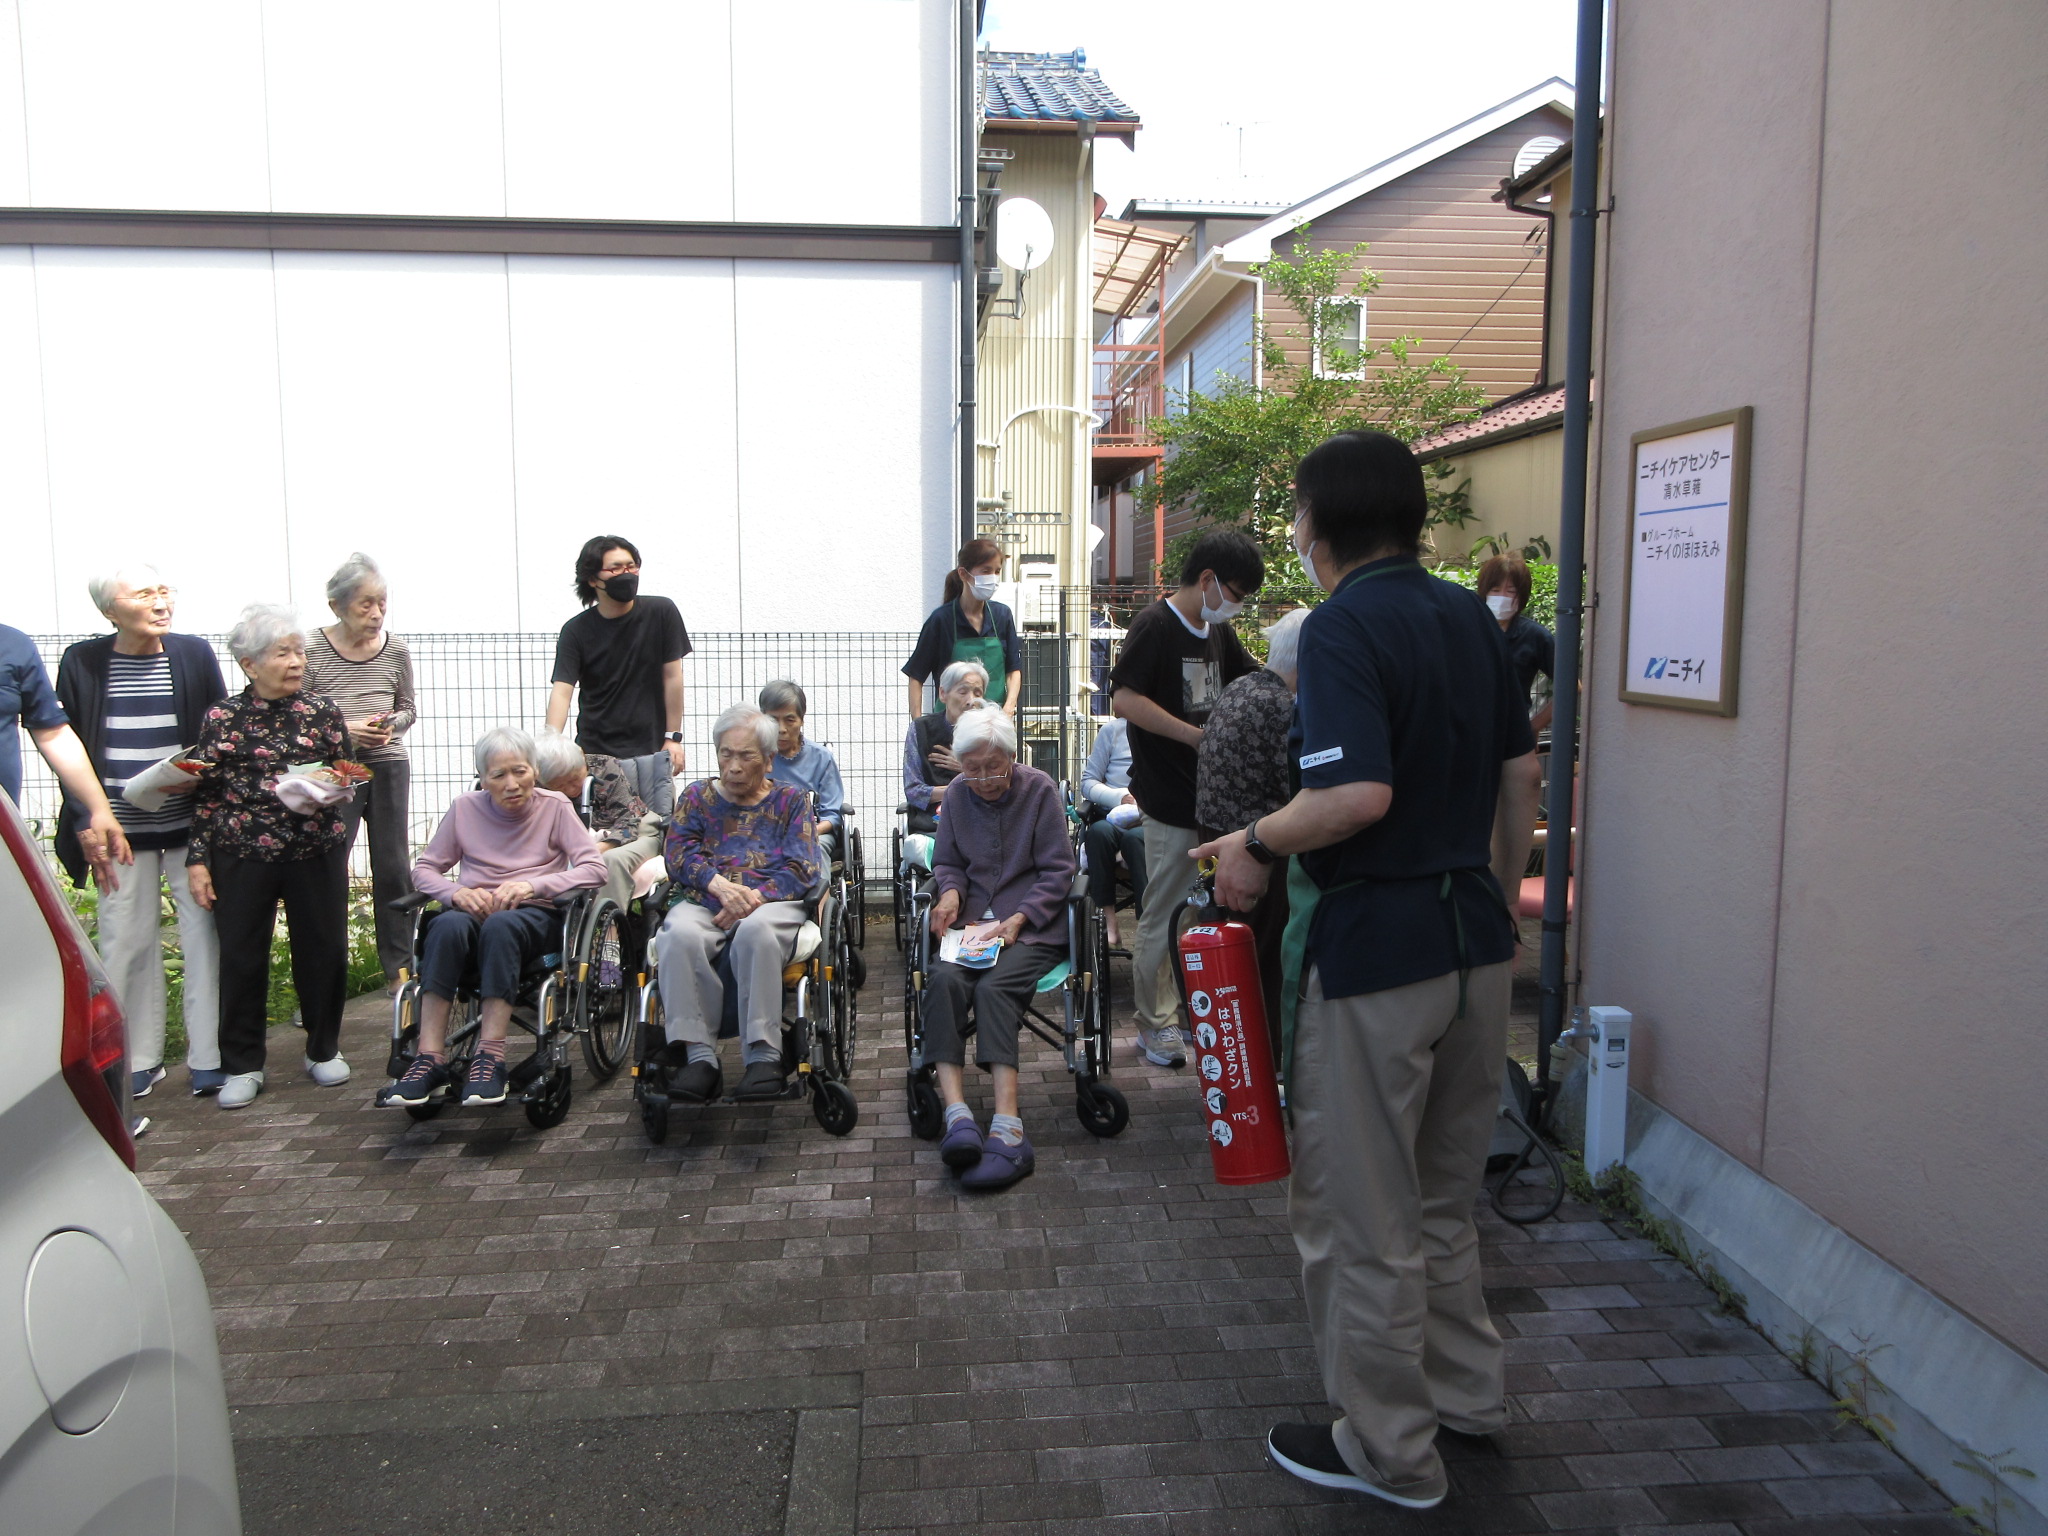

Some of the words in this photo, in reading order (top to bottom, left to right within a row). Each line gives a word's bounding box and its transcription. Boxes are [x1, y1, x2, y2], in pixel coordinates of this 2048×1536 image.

[1641, 449, 1730, 479] ニチイケアセンター
[1664, 479, 1701, 500] 清水草薙
[1648, 526, 1694, 542] グループホーム
[1647, 541, 1720, 560] ニチイのほほえみ
[1668, 658, 1705, 684] ニチイ
[1217, 1007, 1241, 1090] はやわざクン
[1232, 1105, 1260, 1125] YTS-3
